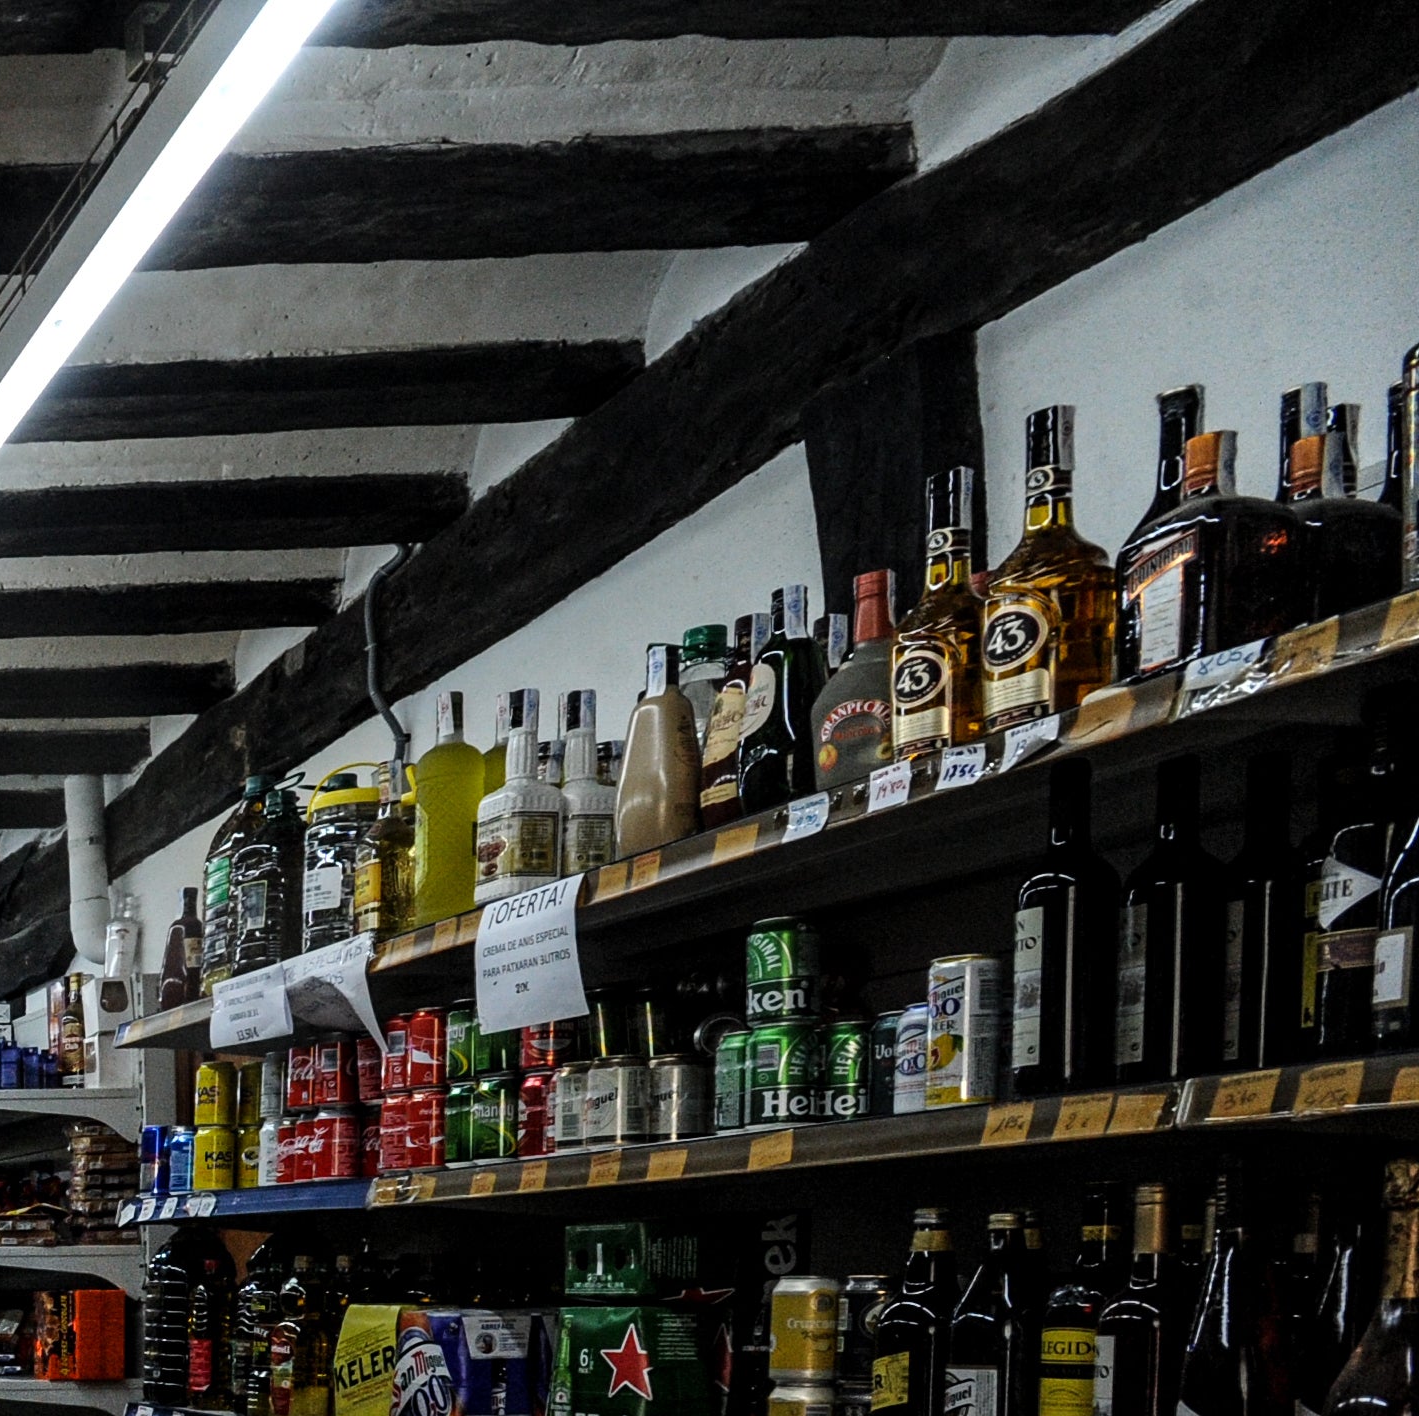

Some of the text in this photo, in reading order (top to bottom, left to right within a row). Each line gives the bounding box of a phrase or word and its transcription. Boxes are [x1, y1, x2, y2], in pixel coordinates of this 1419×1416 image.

[988, 618, 1026, 655] 43
[896, 661, 931, 693] 43
[487, 882, 569, 931] ¡OFERTA!
[482, 925, 569, 959] CREMA DE ANIS ESPECIAL
[482, 966, 500, 979] PARA
[501, 958, 539, 976] PATXARAN
[204, 1151, 234, 1164] KAS
[333, 1345, 396, 1393] KELER
